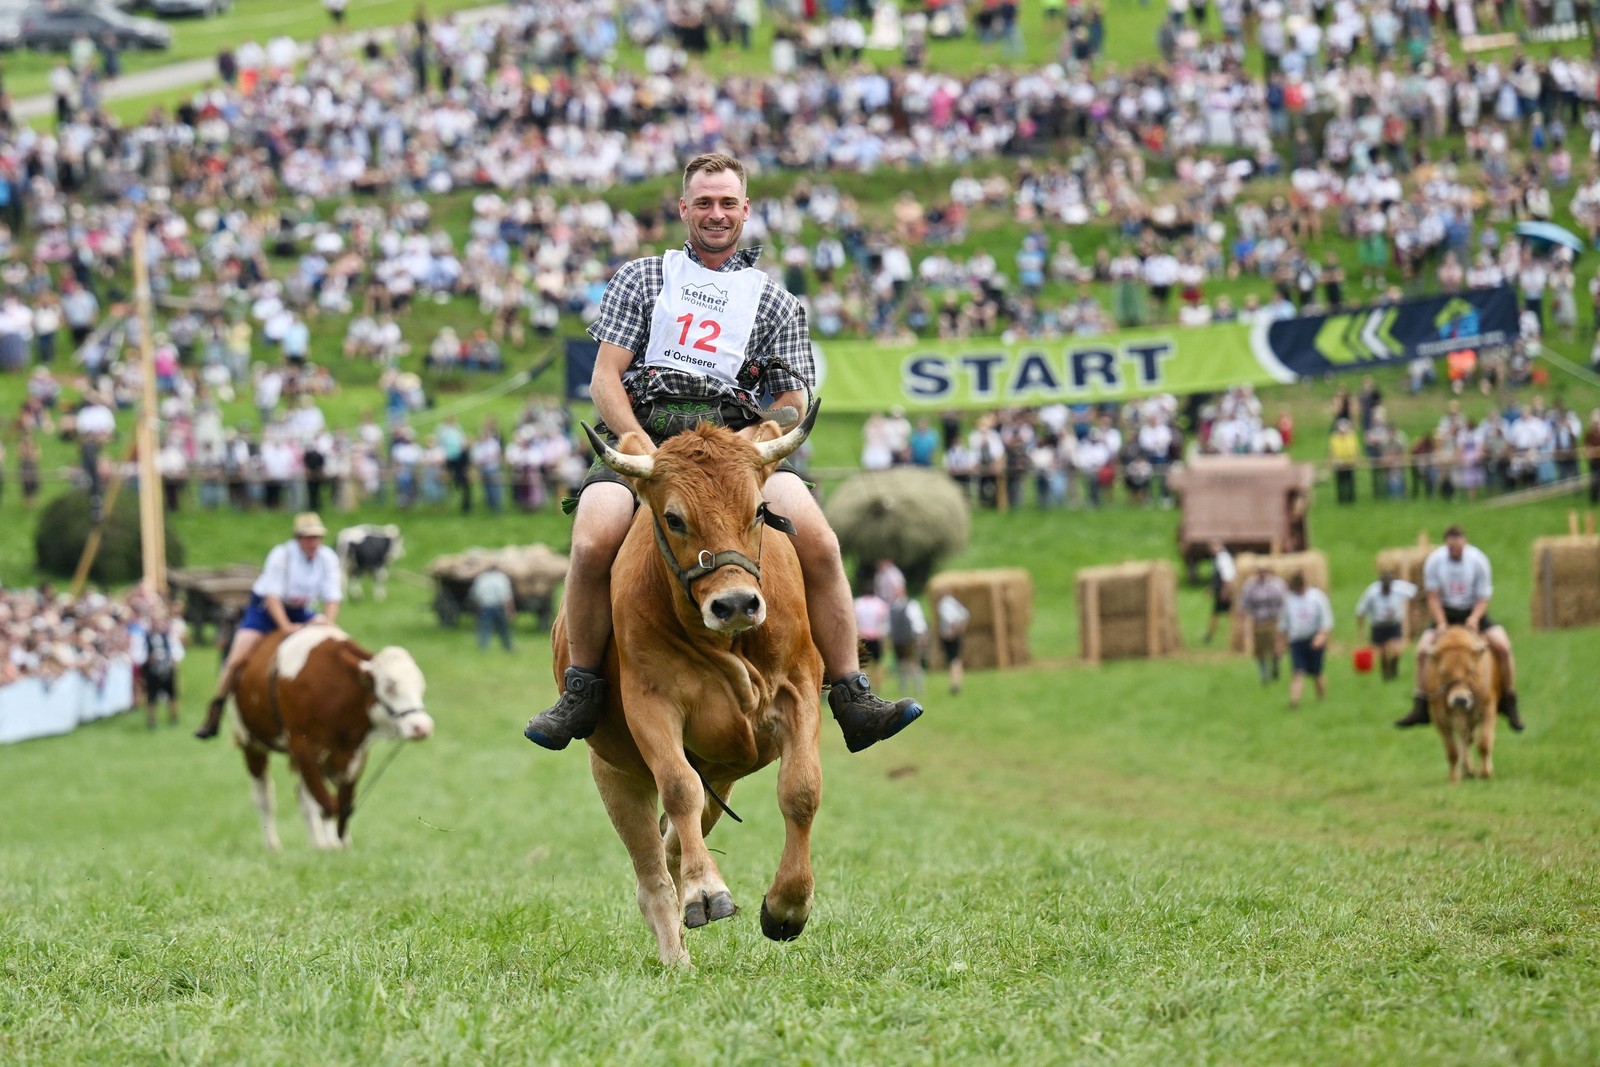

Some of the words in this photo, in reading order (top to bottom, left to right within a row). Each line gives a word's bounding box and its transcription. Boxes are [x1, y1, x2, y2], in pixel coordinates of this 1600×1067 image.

[684, 296, 725, 313] WOHNBAU
[685, 289, 728, 307] Leitner
[676, 312, 721, 353] 12
[909, 345, 1169, 395] START
